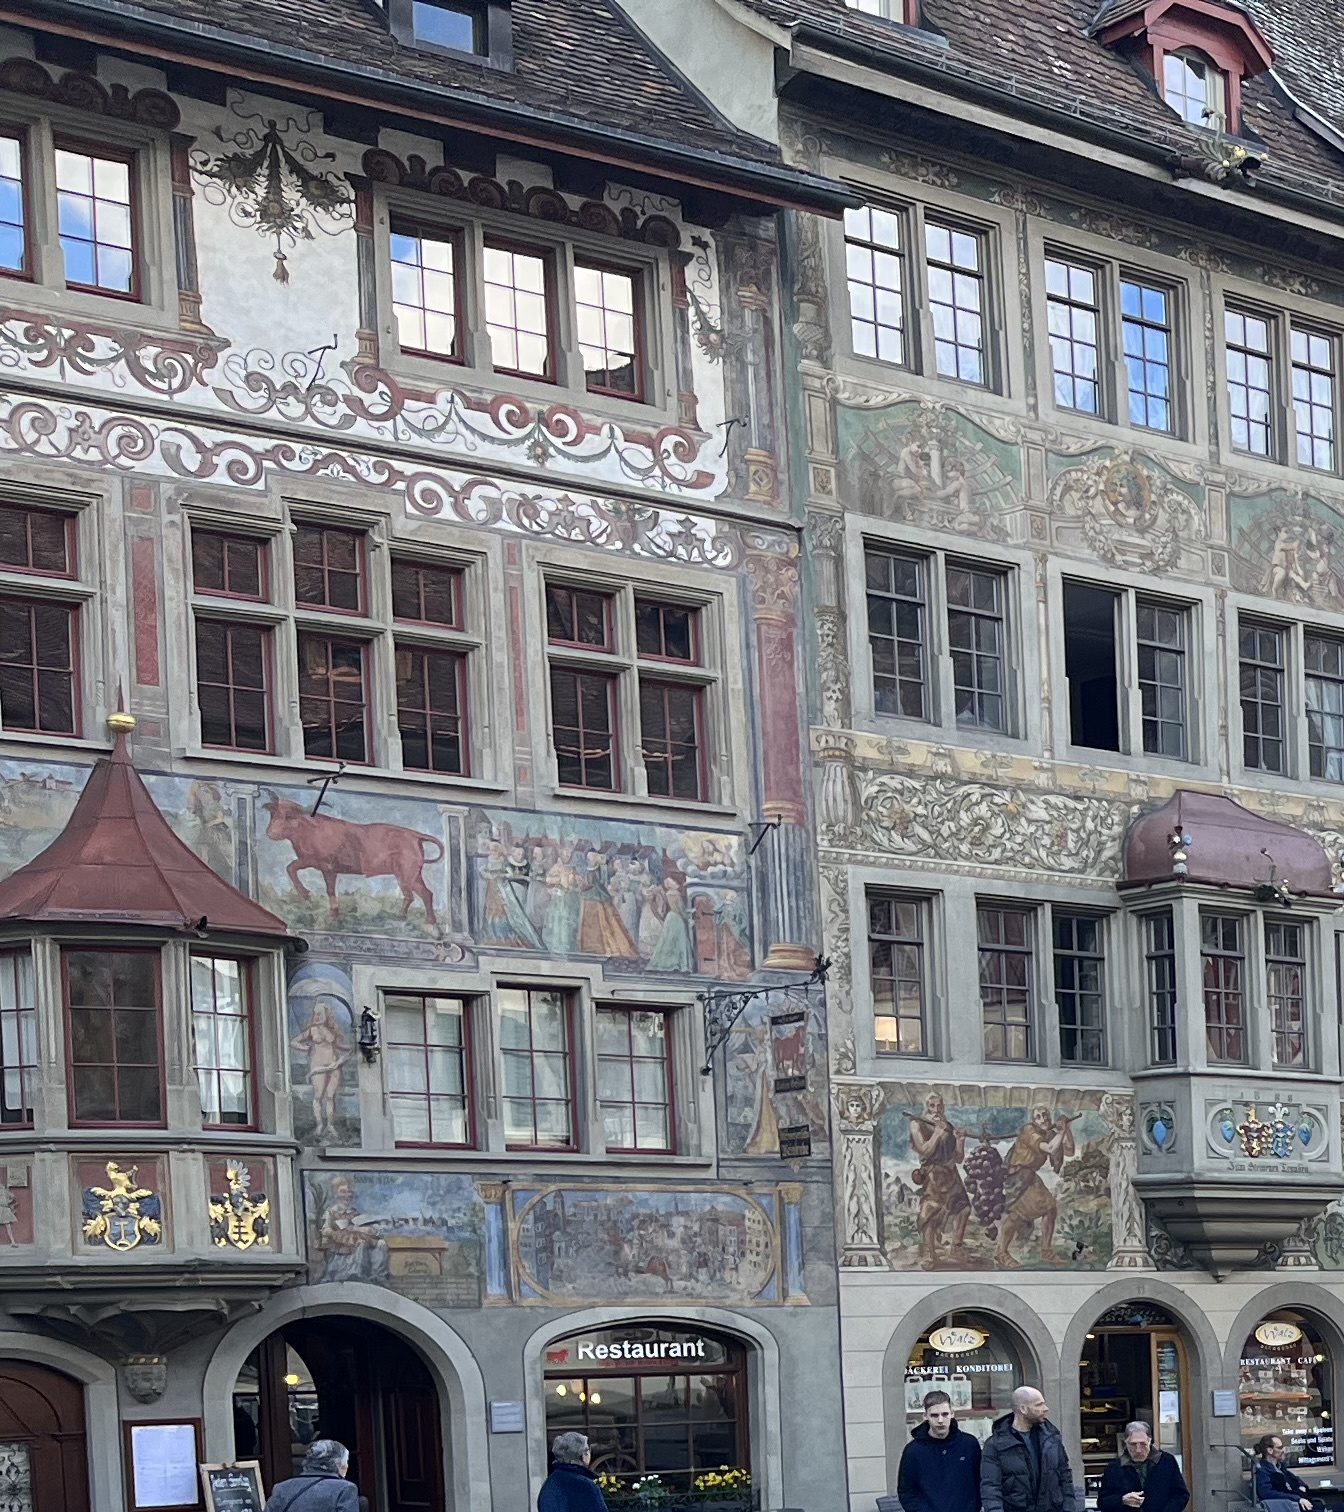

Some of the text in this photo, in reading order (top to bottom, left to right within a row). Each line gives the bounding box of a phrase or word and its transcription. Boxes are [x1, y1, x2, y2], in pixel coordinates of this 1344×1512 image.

[577, 1339, 705, 1360] Restaurant
[1240, 1357, 1292, 1366] RESTAURANT
[956, 1364, 1013, 1373] KONDITOREI
